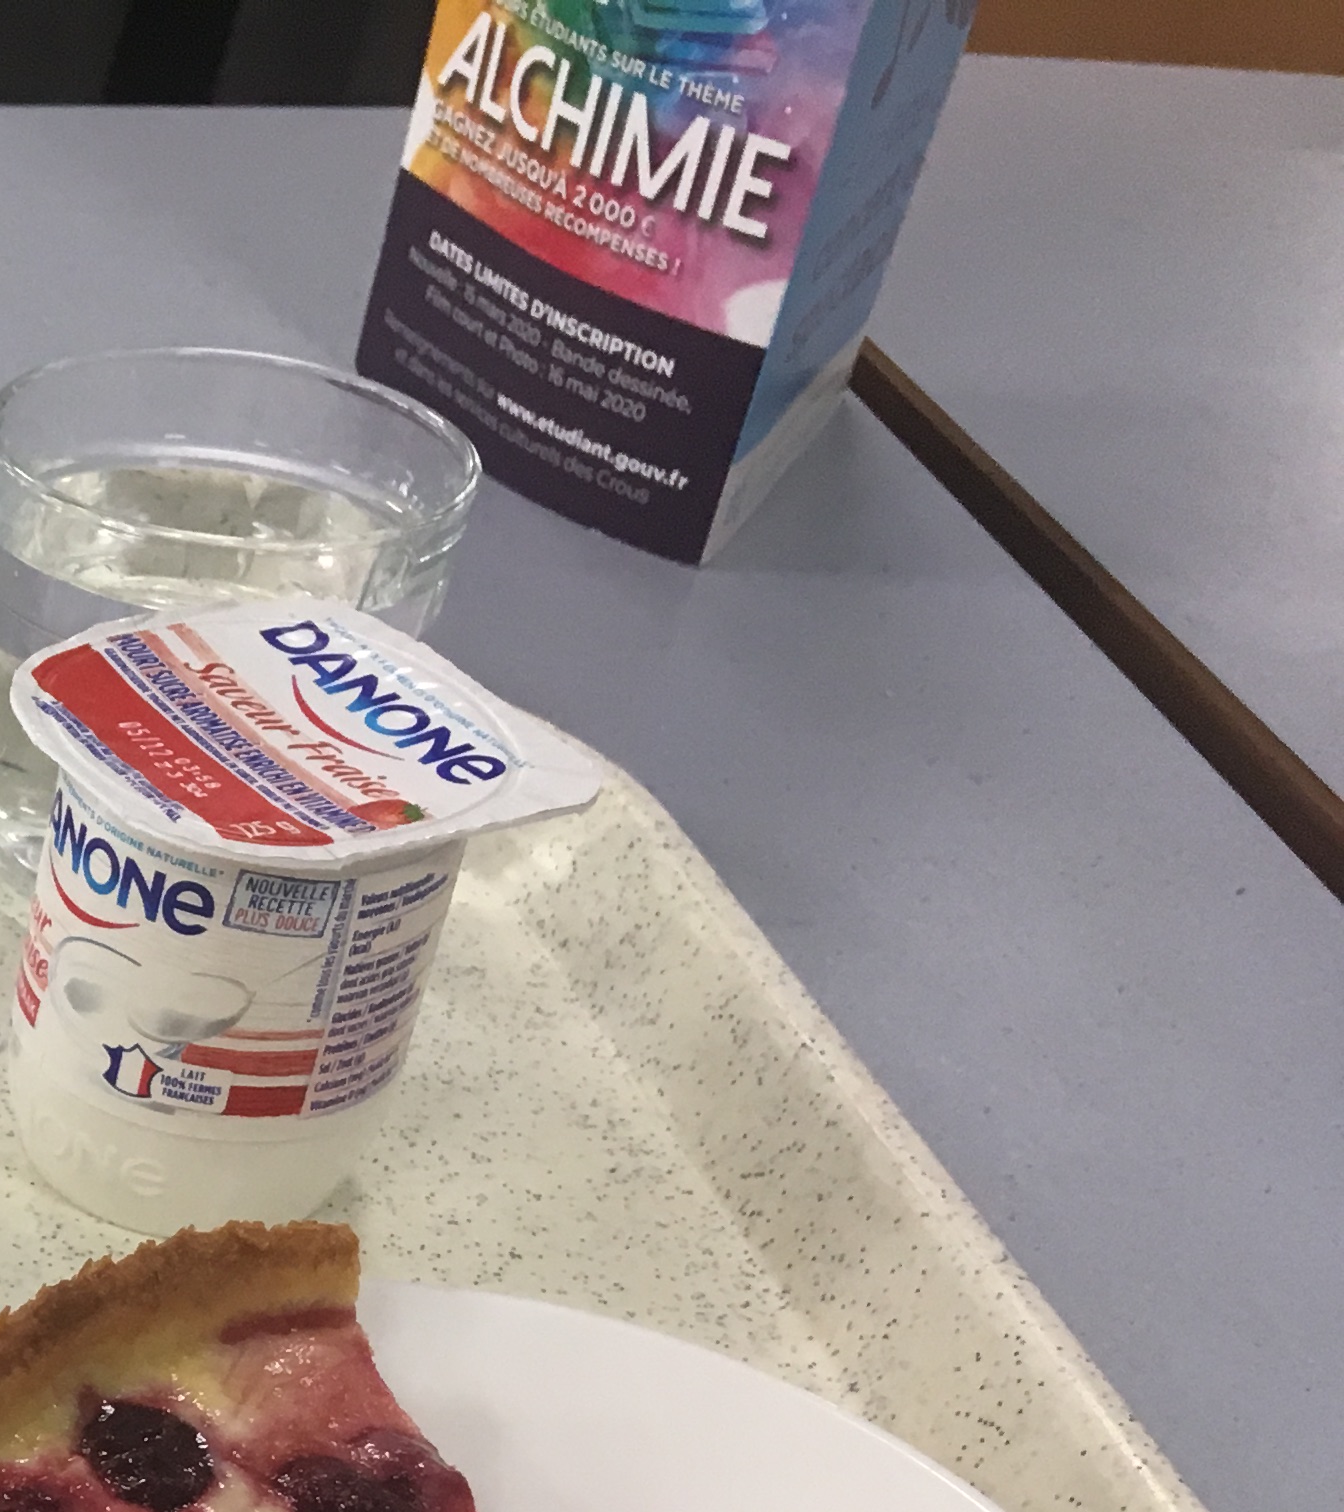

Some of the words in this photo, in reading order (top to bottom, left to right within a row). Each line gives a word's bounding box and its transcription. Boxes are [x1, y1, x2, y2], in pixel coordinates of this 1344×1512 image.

[612, 50, 647, 79] SUR
[648, 65, 673, 89] LE
[437, 11, 791, 239] ALCHIMIE
[434, 100, 497, 154] GAGNEZ
[498, 142, 567, 199] JUSQU'À
[460, 148, 543, 214] NOMBREUSES
[544, 200, 669, 271] RÉCOMPENSES
[428, 229, 474, 274] DATES
[473, 260, 530, 311] LIMITES
[530, 298, 676, 379] D'INSCRIPTION
[551, 337, 606, 379] Bande
[565, 375, 600, 404] mai
[599, 389, 647, 423] 2020
[497, 391, 690, 491] www.etudiant.gouv.fr
[183, 661, 301, 736] Saveur
[287, 740, 401, 799] Fraise
[95, 811, 145, 853] D'ORIGINE
[228, 820, 278, 840] 125
[50, 787, 216, 936] ANONE
[245, 875, 331, 902] NOUVELLE
[248, 893, 315, 917] RECETTE
[234, 909, 271, 927] PLUS
[274, 913, 322, 933] DOUCE
[160, 1073, 187, 1091] 100%
[187, 1082, 222, 1097] FERMES
[180, 1067, 207, 1082] LAIT
